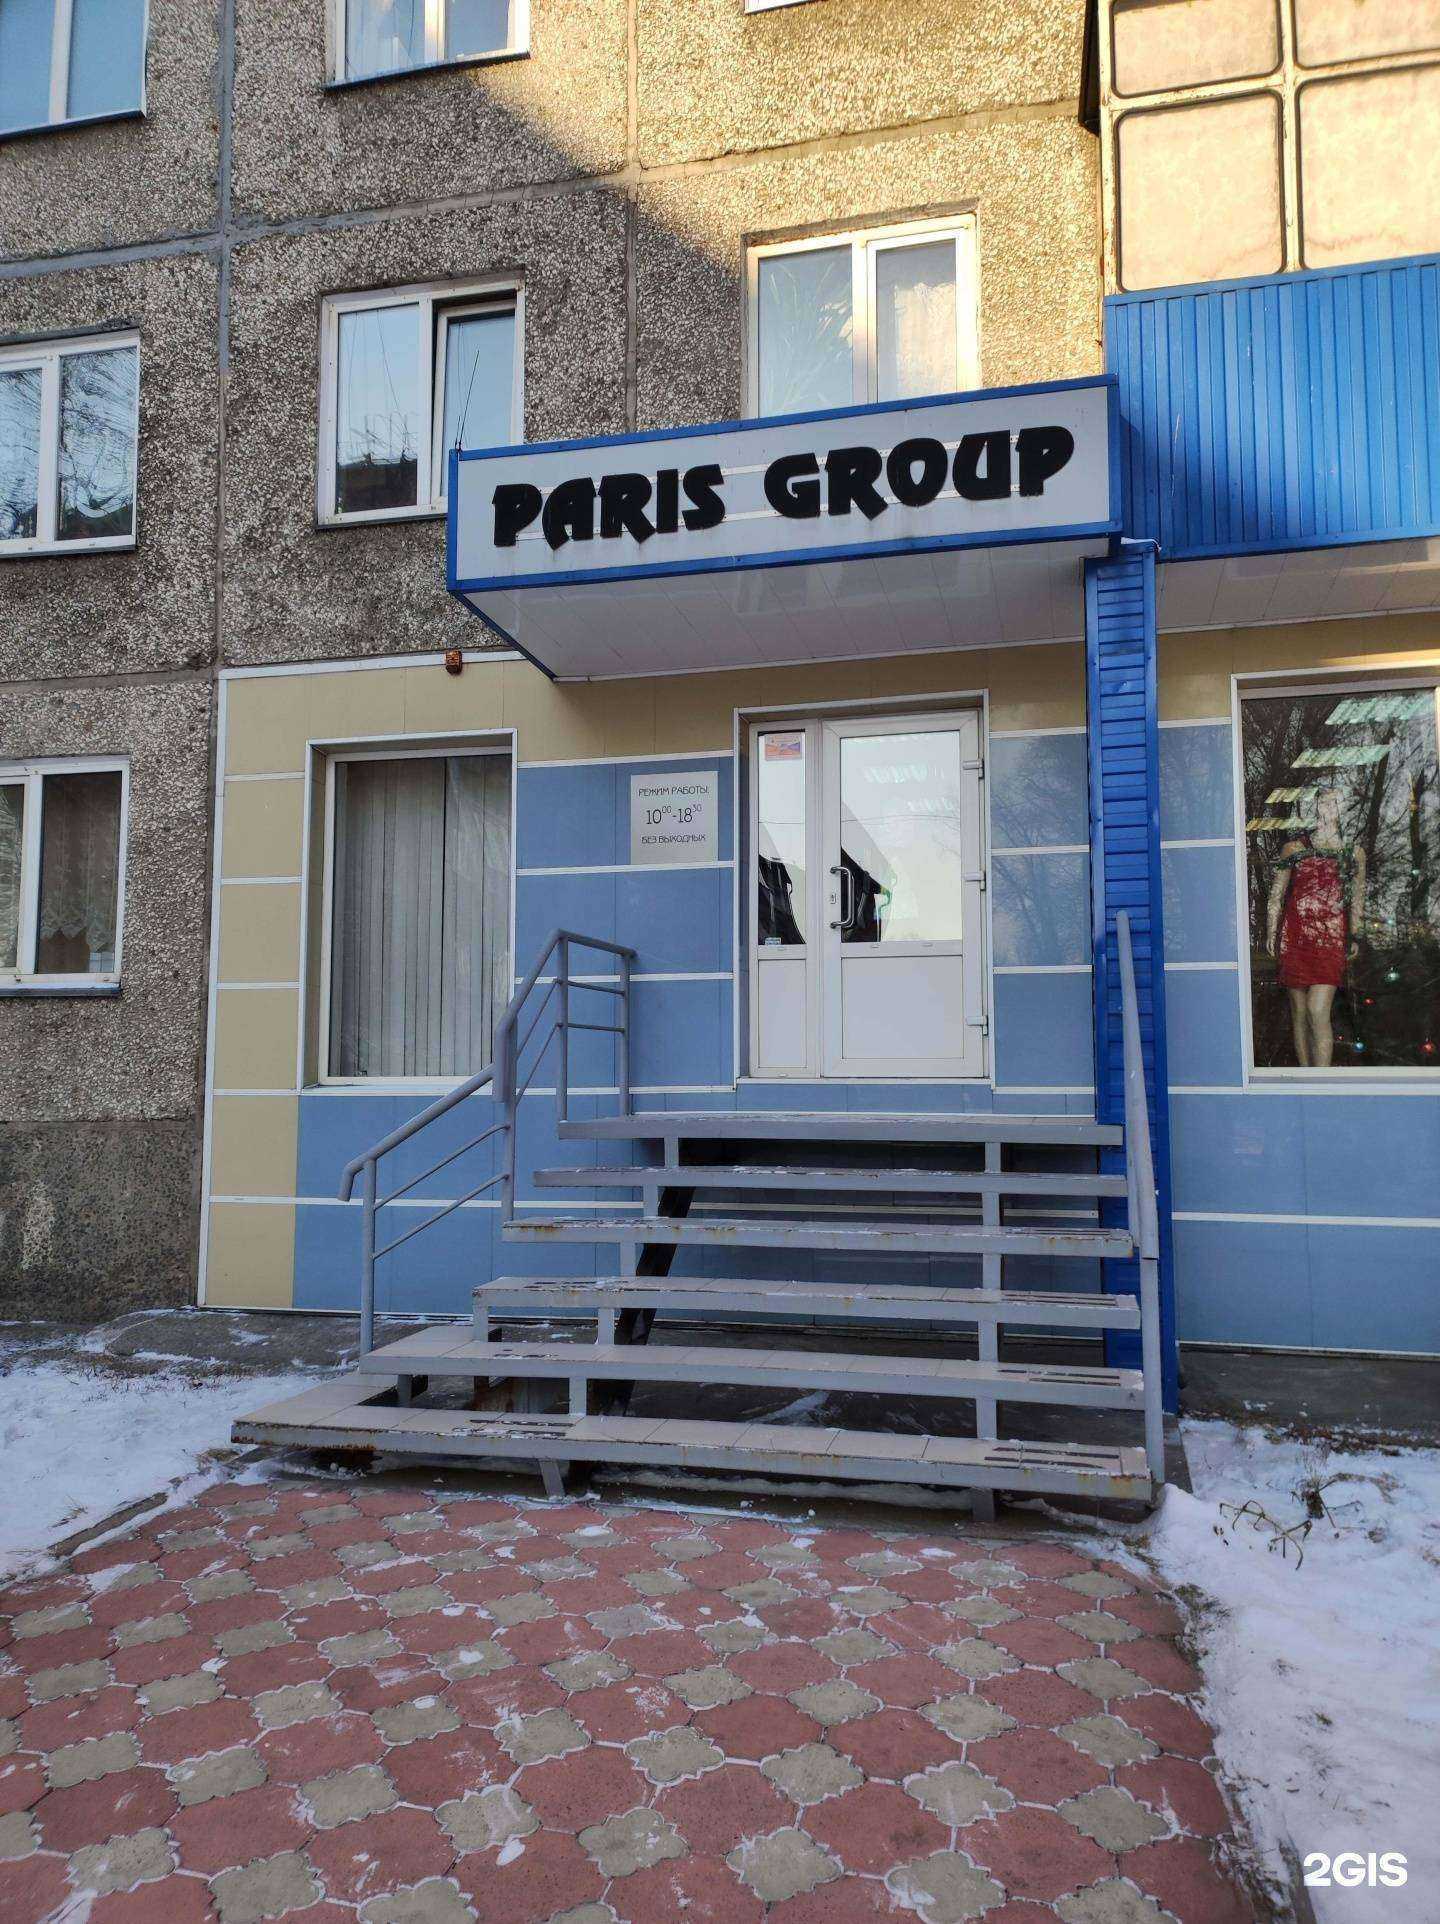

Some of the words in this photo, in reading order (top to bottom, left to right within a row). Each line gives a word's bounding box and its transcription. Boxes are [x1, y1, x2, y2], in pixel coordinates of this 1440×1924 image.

[491, 463, 728, 552] PARIS
[762, 424, 1076, 521] GROUP
[638, 787, 670, 797] РЕЖИМ
[641, 836, 657, 844] БЕЗ
